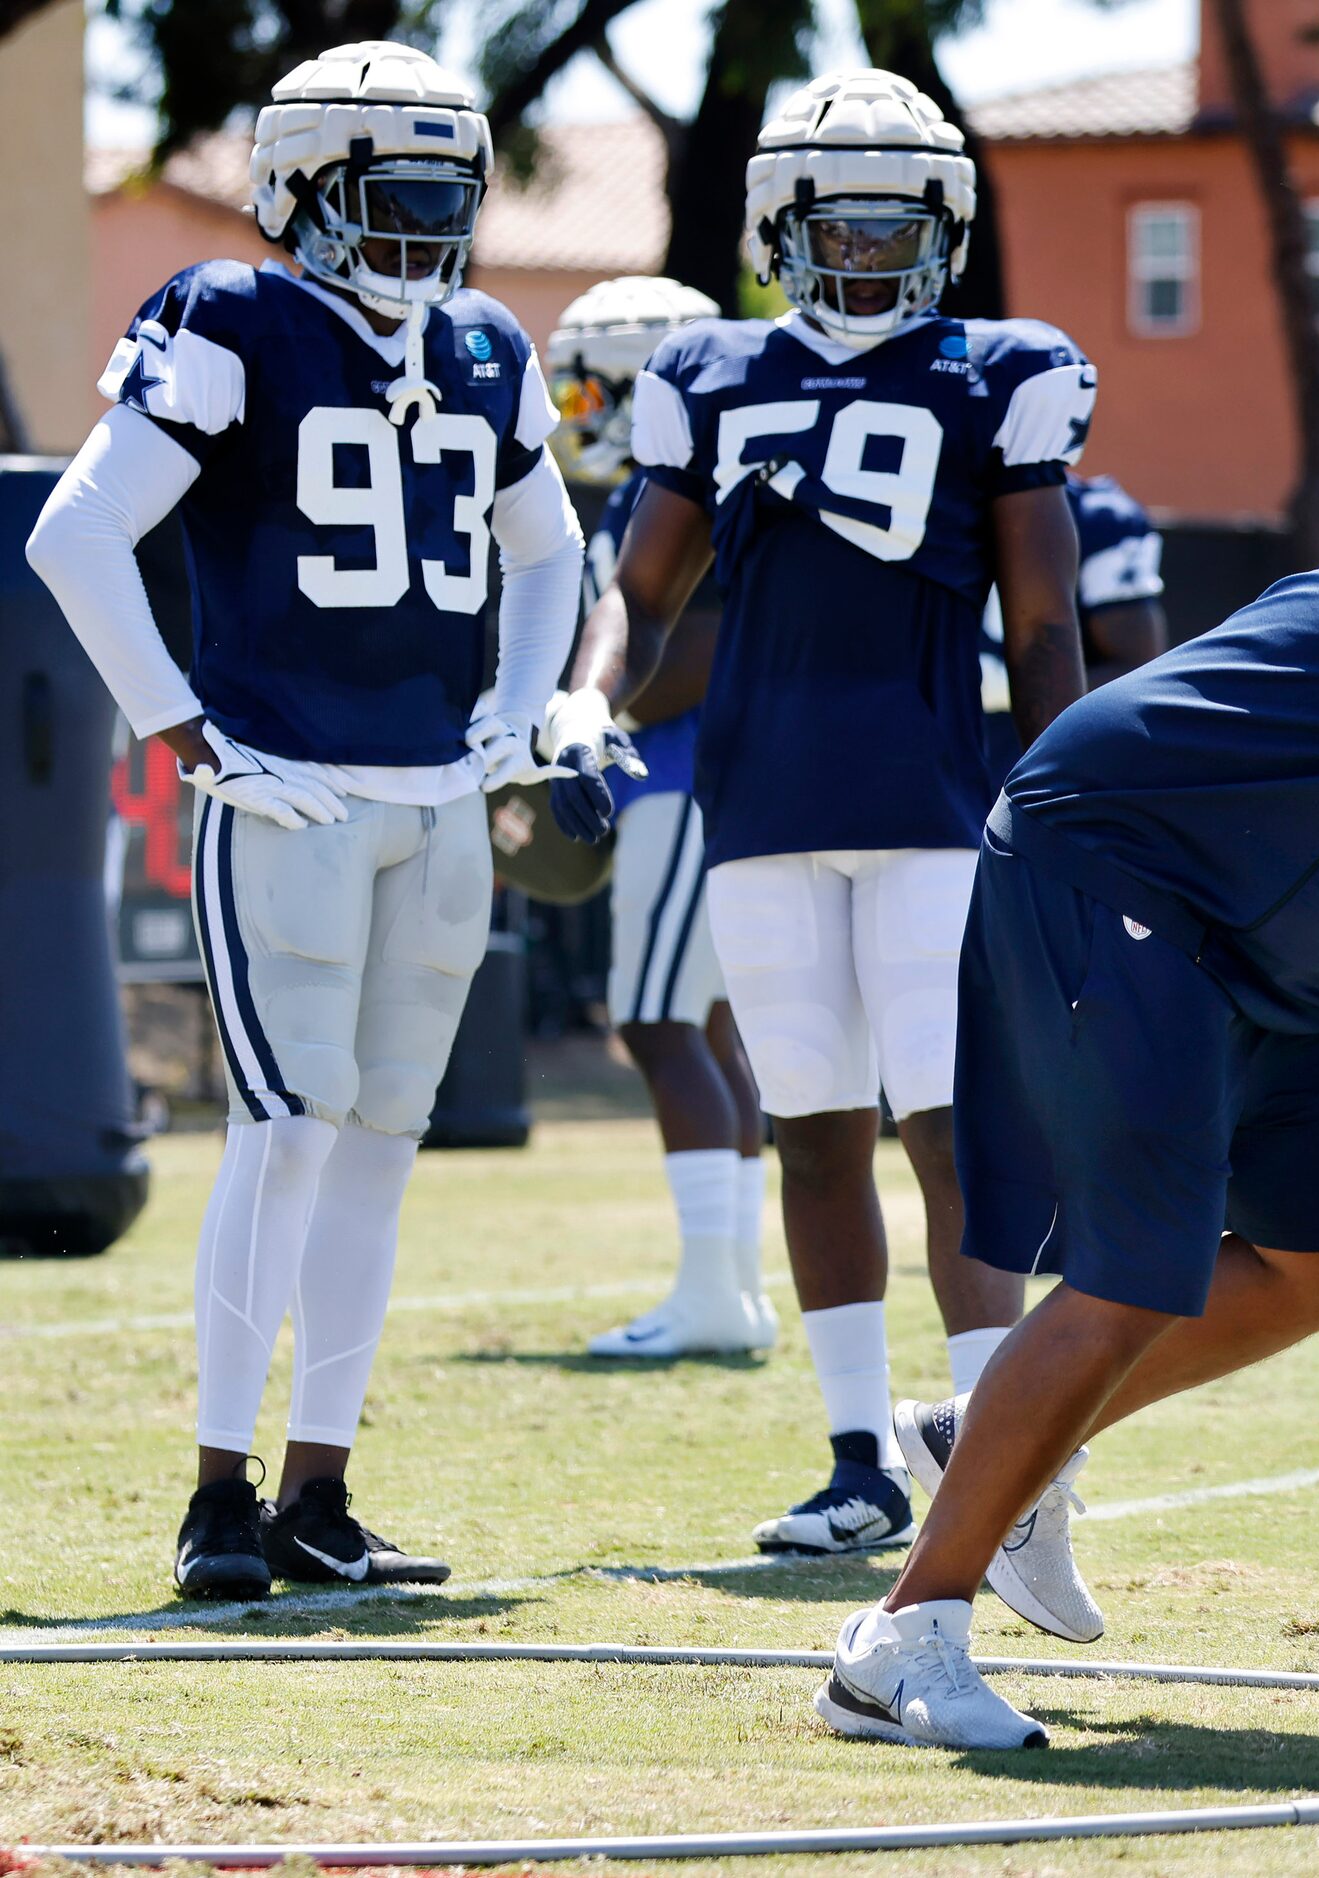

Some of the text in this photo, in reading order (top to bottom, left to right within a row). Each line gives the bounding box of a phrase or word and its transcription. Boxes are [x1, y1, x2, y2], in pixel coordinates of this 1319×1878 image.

[473, 362, 501, 379] AT&T
[296, 406, 498, 615] 93
[714, 399, 944, 562] 59
